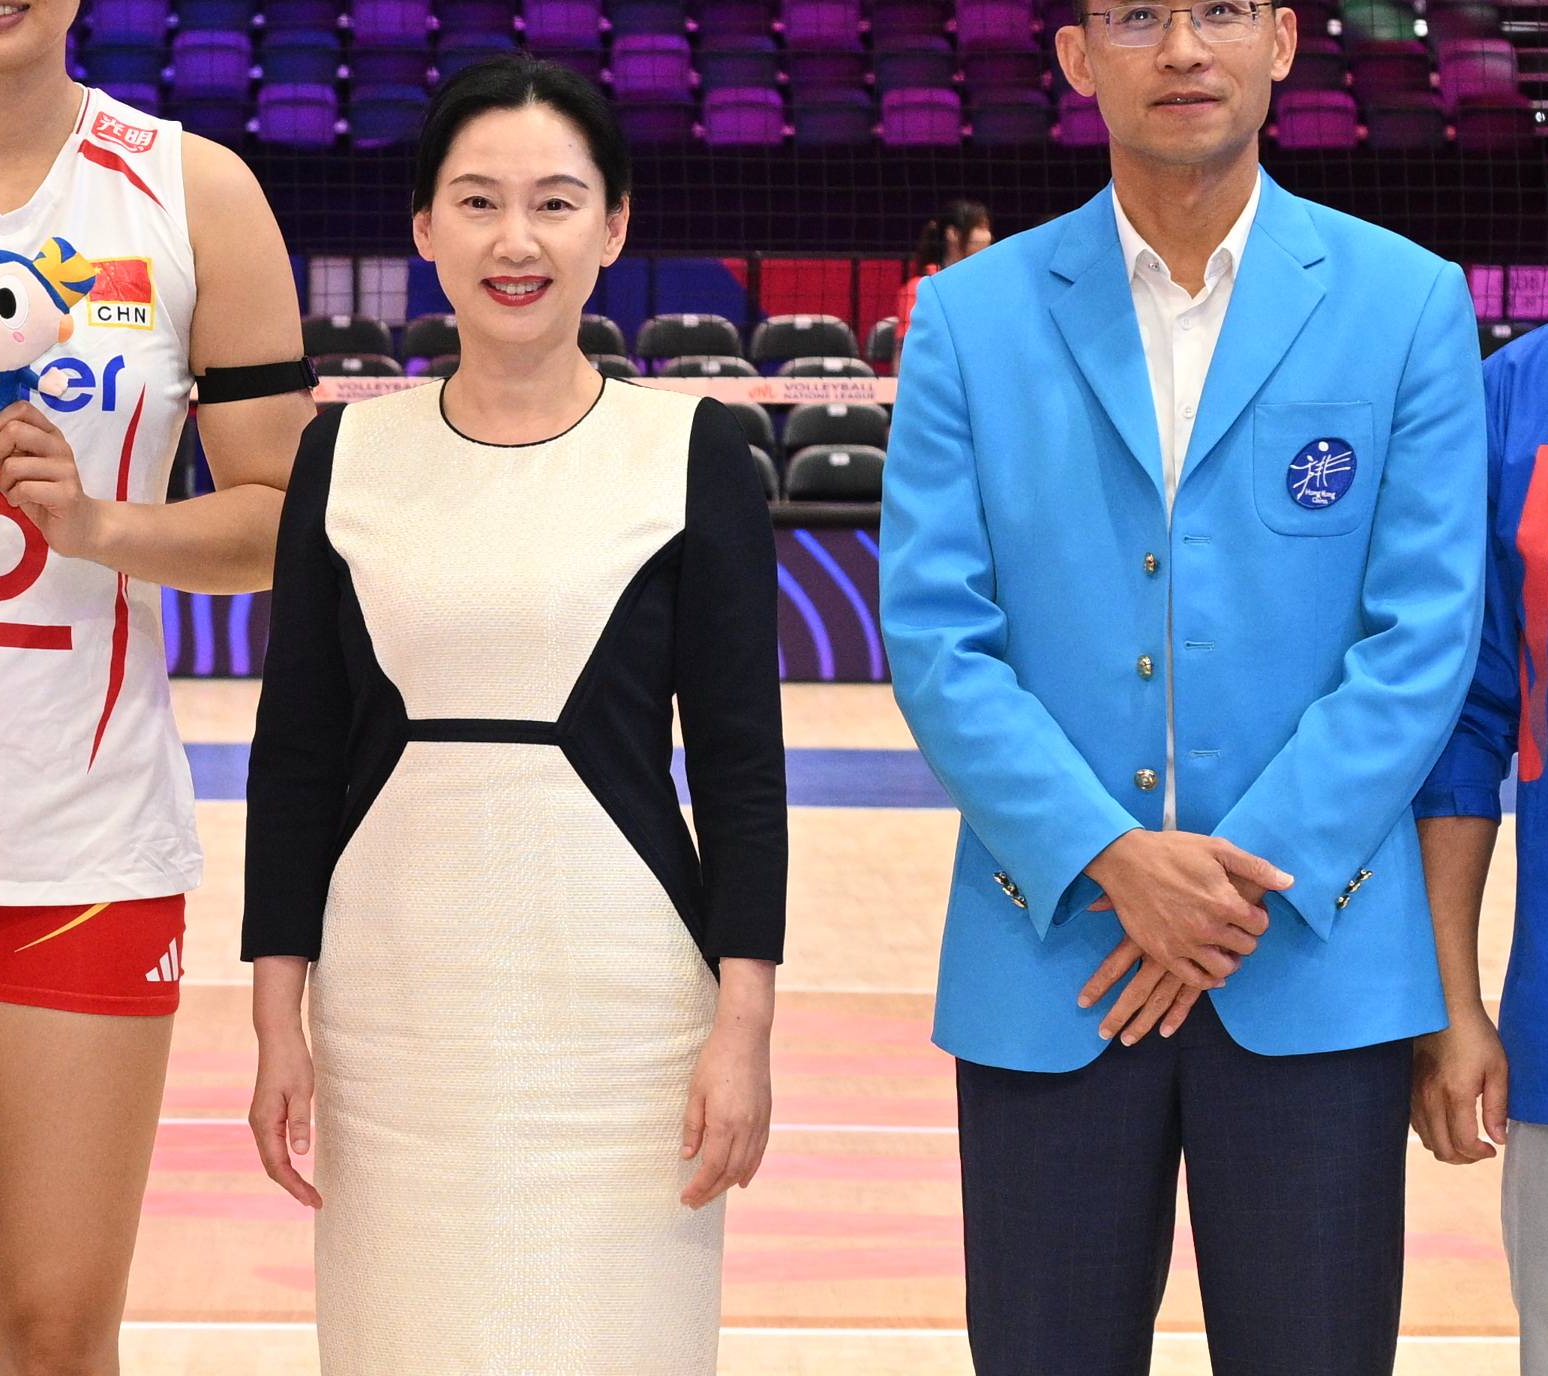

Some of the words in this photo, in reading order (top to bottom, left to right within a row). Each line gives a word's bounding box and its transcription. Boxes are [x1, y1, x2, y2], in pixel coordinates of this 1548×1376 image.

[96, 115, 153, 145] 光明
[97, 306, 147, 324] CHN
[784, 383, 874, 392] VOLLEYBALL
